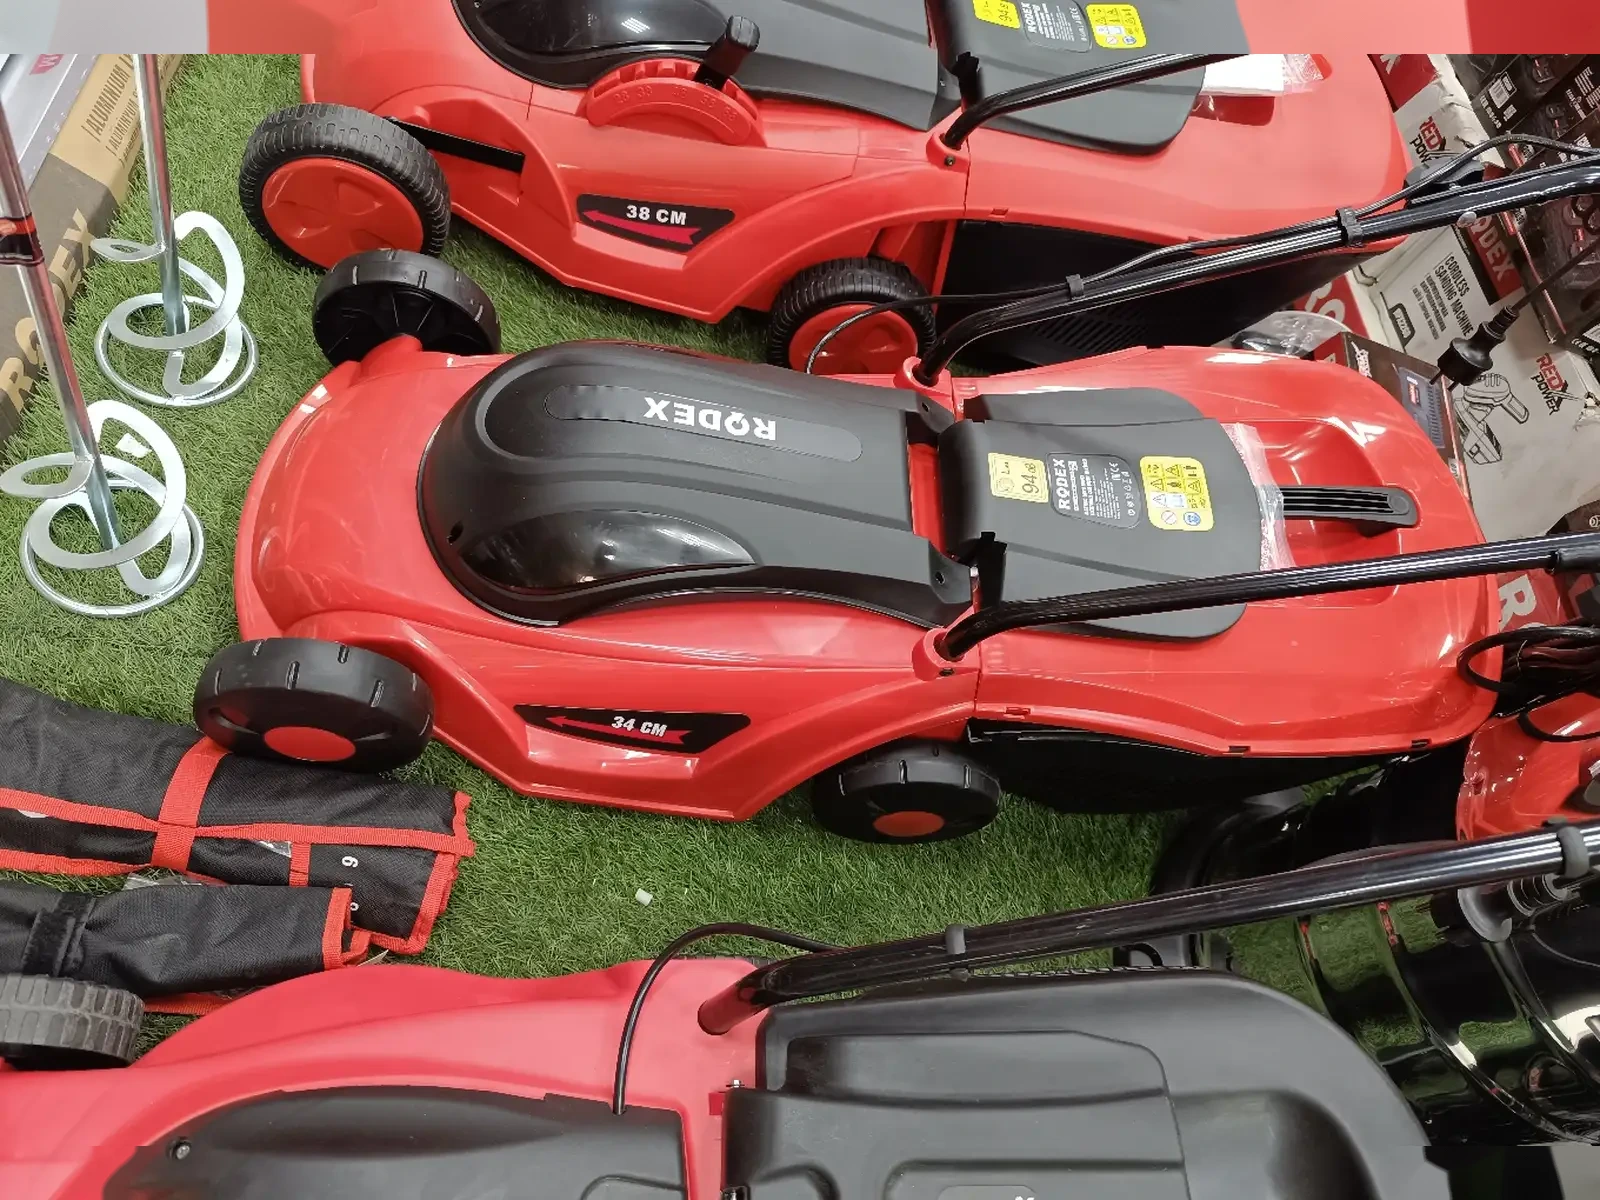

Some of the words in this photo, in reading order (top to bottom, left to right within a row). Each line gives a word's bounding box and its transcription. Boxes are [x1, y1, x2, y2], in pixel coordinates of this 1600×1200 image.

[86, 64, 131, 136] ALUMINIUM
[1410, 134, 1432, 163] POW
[626, 205, 650, 220] 38
[656, 209, 687, 225] CM
[1445, 256, 1470, 297] CORDLESS
[1435, 265, 1458, 300] SANDING
[1450, 299, 1474, 337] MACHINE
[1536, 352, 1565, 391] RED
[1530, 372, 1560, 415] POWER
[643, 397, 776, 441] RODEX
[1052, 458, 1072, 510] RODEX
[611, 716, 636, 731] 34
[640, 721, 667, 737] CM
